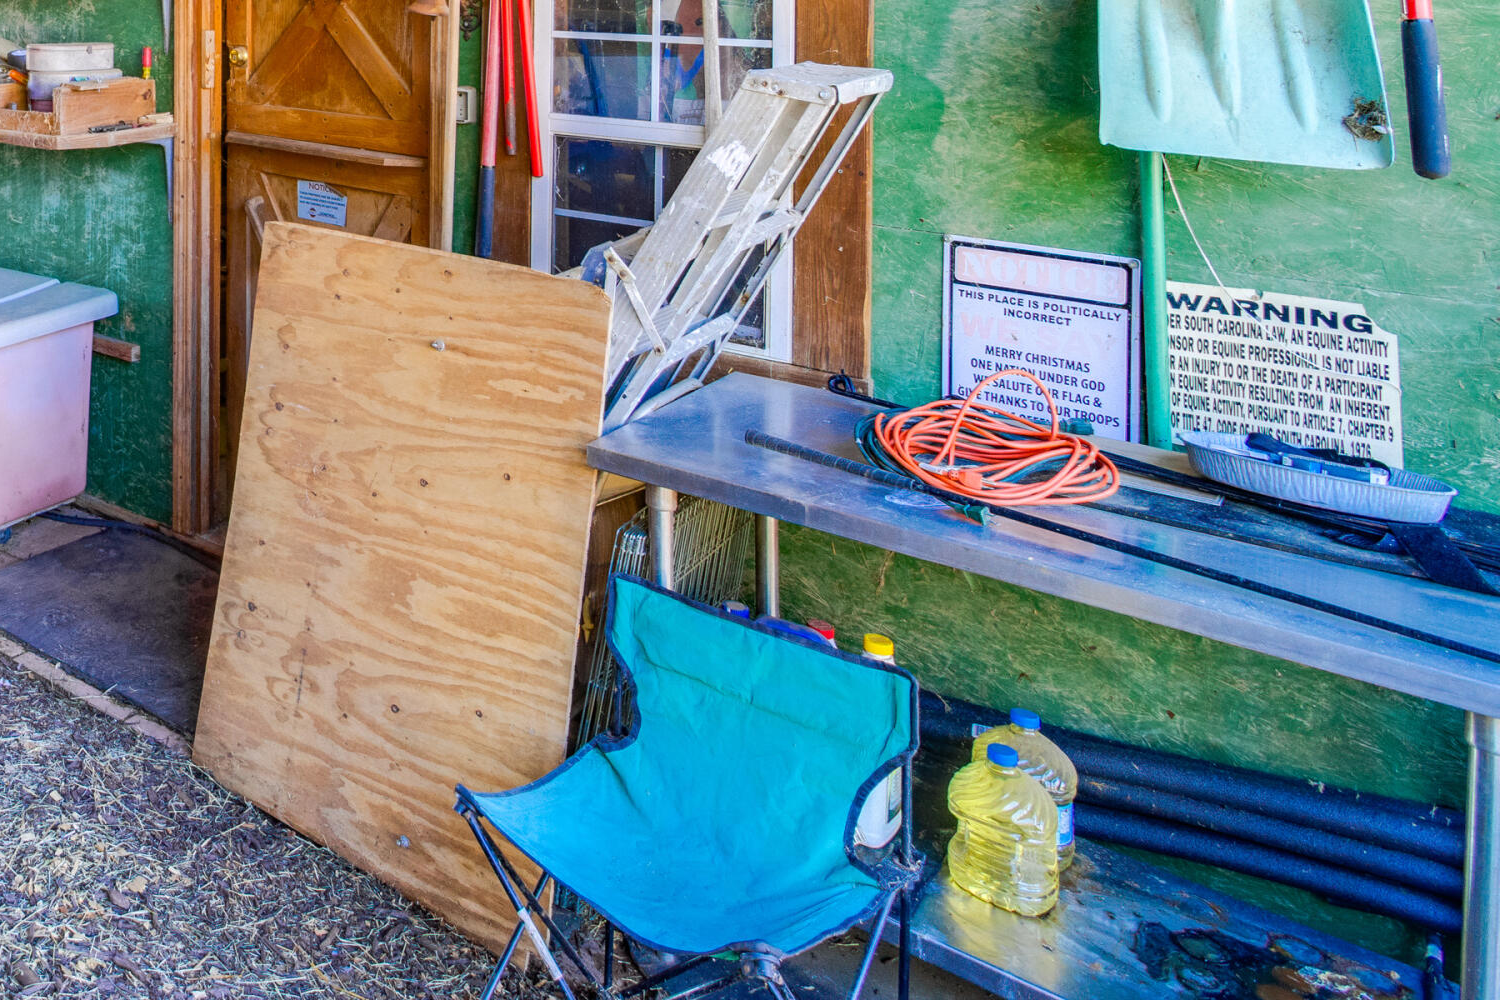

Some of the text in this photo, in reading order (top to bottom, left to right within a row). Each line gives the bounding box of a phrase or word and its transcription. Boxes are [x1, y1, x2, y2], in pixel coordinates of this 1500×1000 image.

[962, 250, 1120, 299] NOTICE
[958, 288, 1122, 322] THIS PLACE IS POLITICALLY
[1003, 307, 1073, 326] INCORRECT
[1166, 291, 1373, 335] WARNING
[1184, 315, 1214, 333] SOUTH
[1216, 319, 1263, 340] CAROLINA
[1291, 328, 1304, 345] AN
[1307, 330, 1344, 351] EQUINE
[1347, 336, 1389, 358] ACTIVITY
[970, 357, 1106, 392] ONE NATON UNDER GOD
[985, 345, 1090, 373] MERRY CHRISTMAS
[1178, 355, 1189, 372] AN
[1192, 357, 1221, 377] INJURY
[1223, 361, 1234, 378] TO
[1236, 364, 1249, 381] OR
[1251, 366, 1268, 384] THE
[1270, 368, 1298, 388] DEATH
[1301, 373, 1313, 390] OF
[1315, 375, 1322, 392] A
[1324, 376, 1383, 402] PARTICIPANT
[1197, 338, 1210, 354] OR
[1212, 340, 1246, 359] EQUINE
[1248, 344, 1320, 370] PROFESSIONAL
[1322, 355, 1332, 371] IS
[1335, 356, 1354, 375] NOT
[1357, 360, 1390, 381] LIABLE
[984, 390, 1028, 409] THANKS
[1030, 400, 1045, 412] TO
[1073, 408, 1120, 428] TROOPS
[992, 378, 1033, 396] SALUTE
[1062, 390, 1091, 406] FLAG
[1093, 397, 1103, 408] &
[1178, 373, 1209, 392] EQUINE
[1211, 378, 1247, 399] ACTIVITY
[1248, 384, 1296, 406] RESULTING
[1298, 391, 1324, 411] FROM
[1329, 397, 1342, 414] AN
[1344, 398, 1390, 422] INHERENT
[1170, 411, 1180, 428] OF
[1182, 413, 1201, 432] TITLE
[1216, 418, 1237, 434] CODE
[1239, 422, 1250, 436] OF
[1276, 429, 1302, 446] SOUTH
[1172, 391, 1395, 443] OF EQUINE ACTIVITY, PURSUANT TO ARTICLE 7, CHAPTER 9
